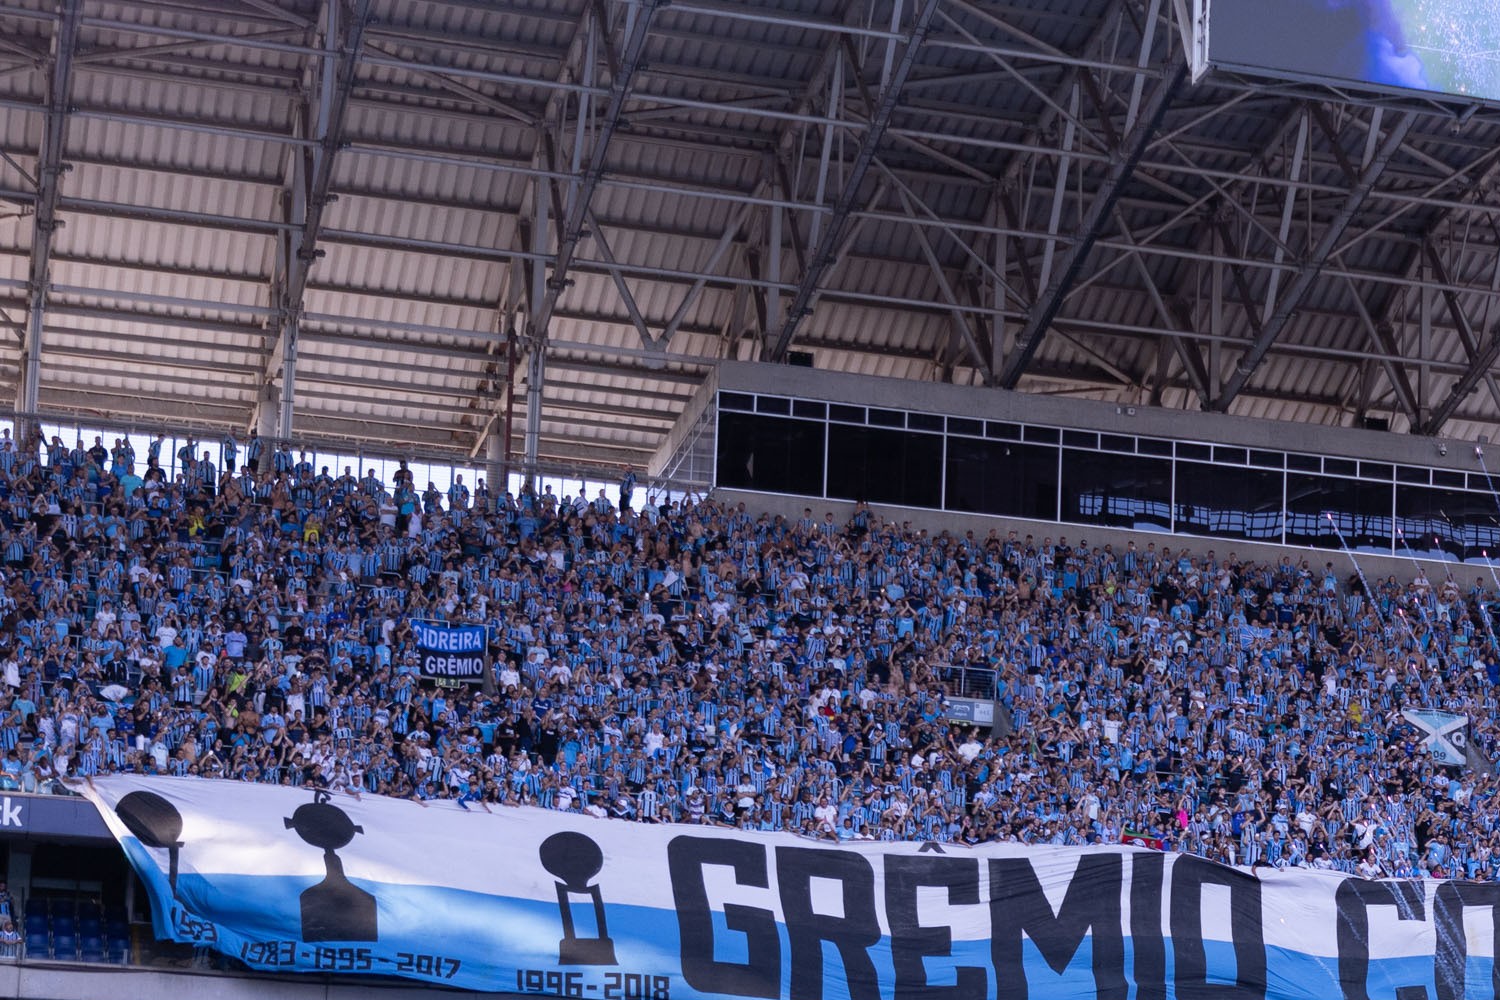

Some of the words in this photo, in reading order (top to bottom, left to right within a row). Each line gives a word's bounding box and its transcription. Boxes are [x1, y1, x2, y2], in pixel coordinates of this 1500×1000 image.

[425, 654, 483, 676] GRÊMIO
[0, 797, 23, 827] k
[517, 969, 670, 1000] 1996-2018
